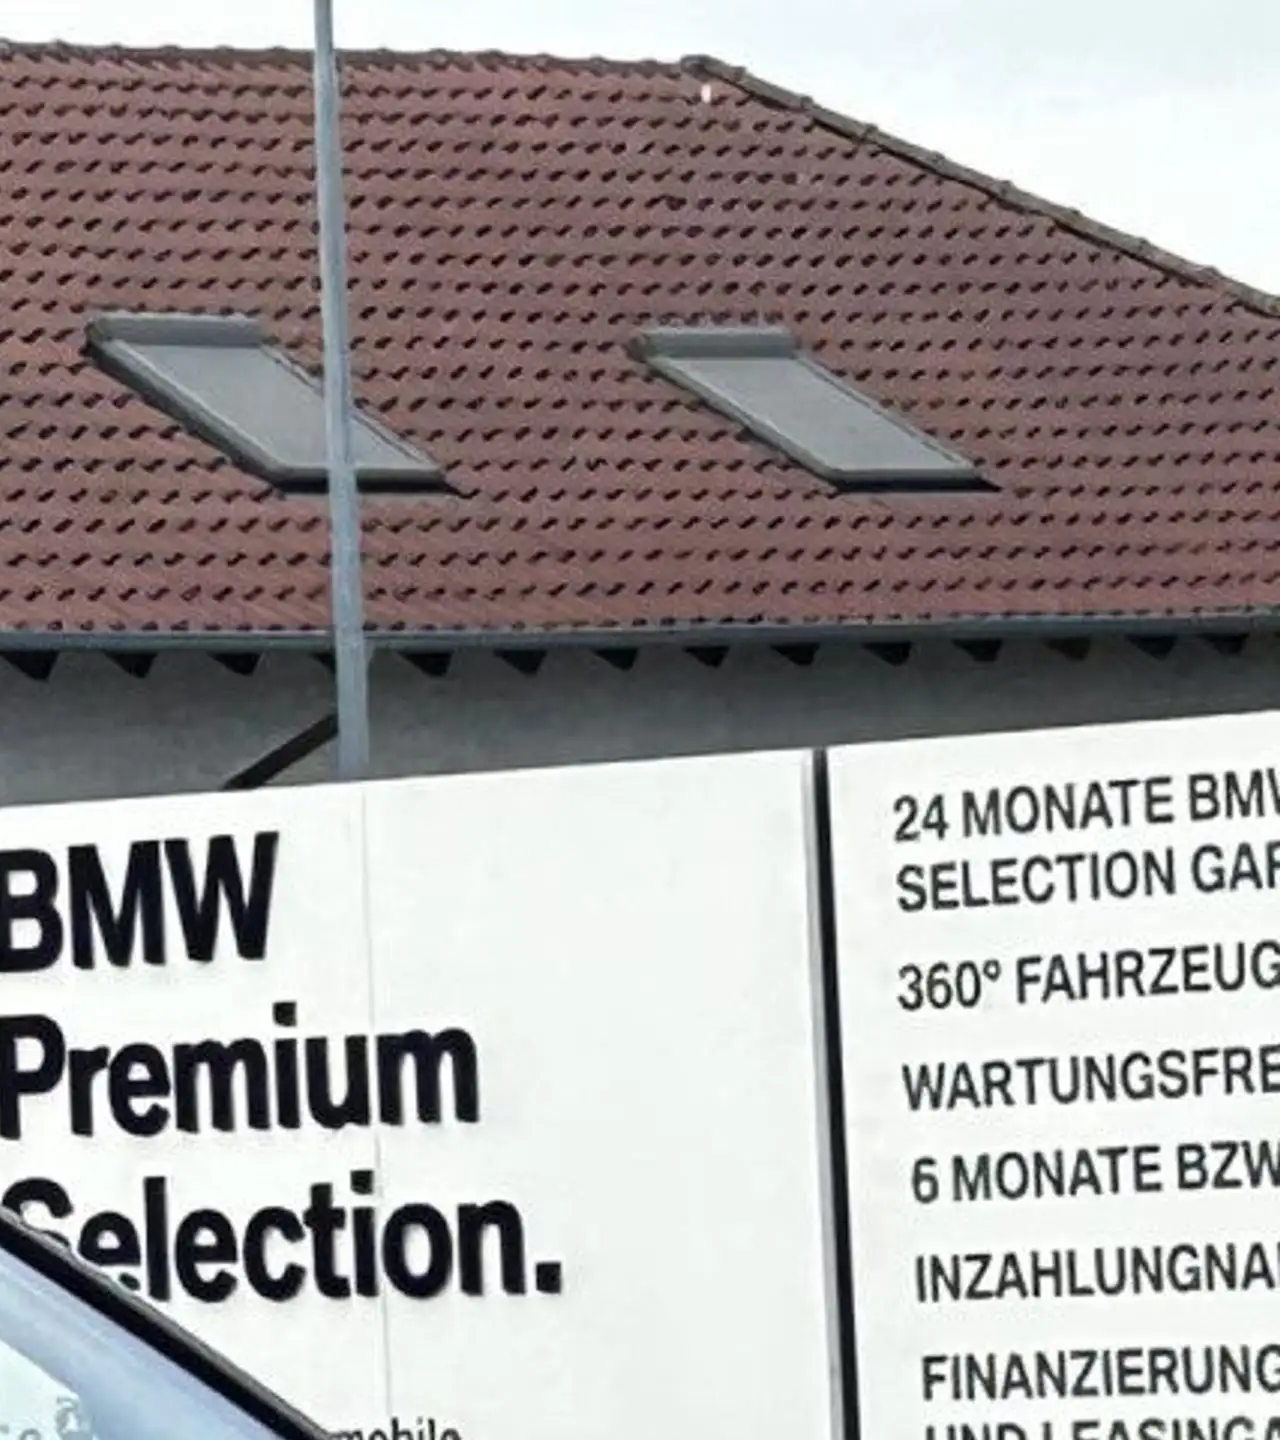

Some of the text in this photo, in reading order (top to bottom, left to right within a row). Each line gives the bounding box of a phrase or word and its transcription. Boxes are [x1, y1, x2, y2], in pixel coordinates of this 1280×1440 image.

[893, 794, 949, 842] 24
[962, 776, 1175, 837] MONATE
[896, 846, 1177, 913] SELECTION
[897, 940, 1280, 1012] 360° FAHRZEUG
[902, 1043, 1280, 1111] WARTUNGSFRE
[912, 1139, 1280, 1204] 6 MONATE BZW
[916, 1242, 1280, 1303] INZAHLUNGNA
[922, 1343, 1280, 1401] FINANZIERUNG
